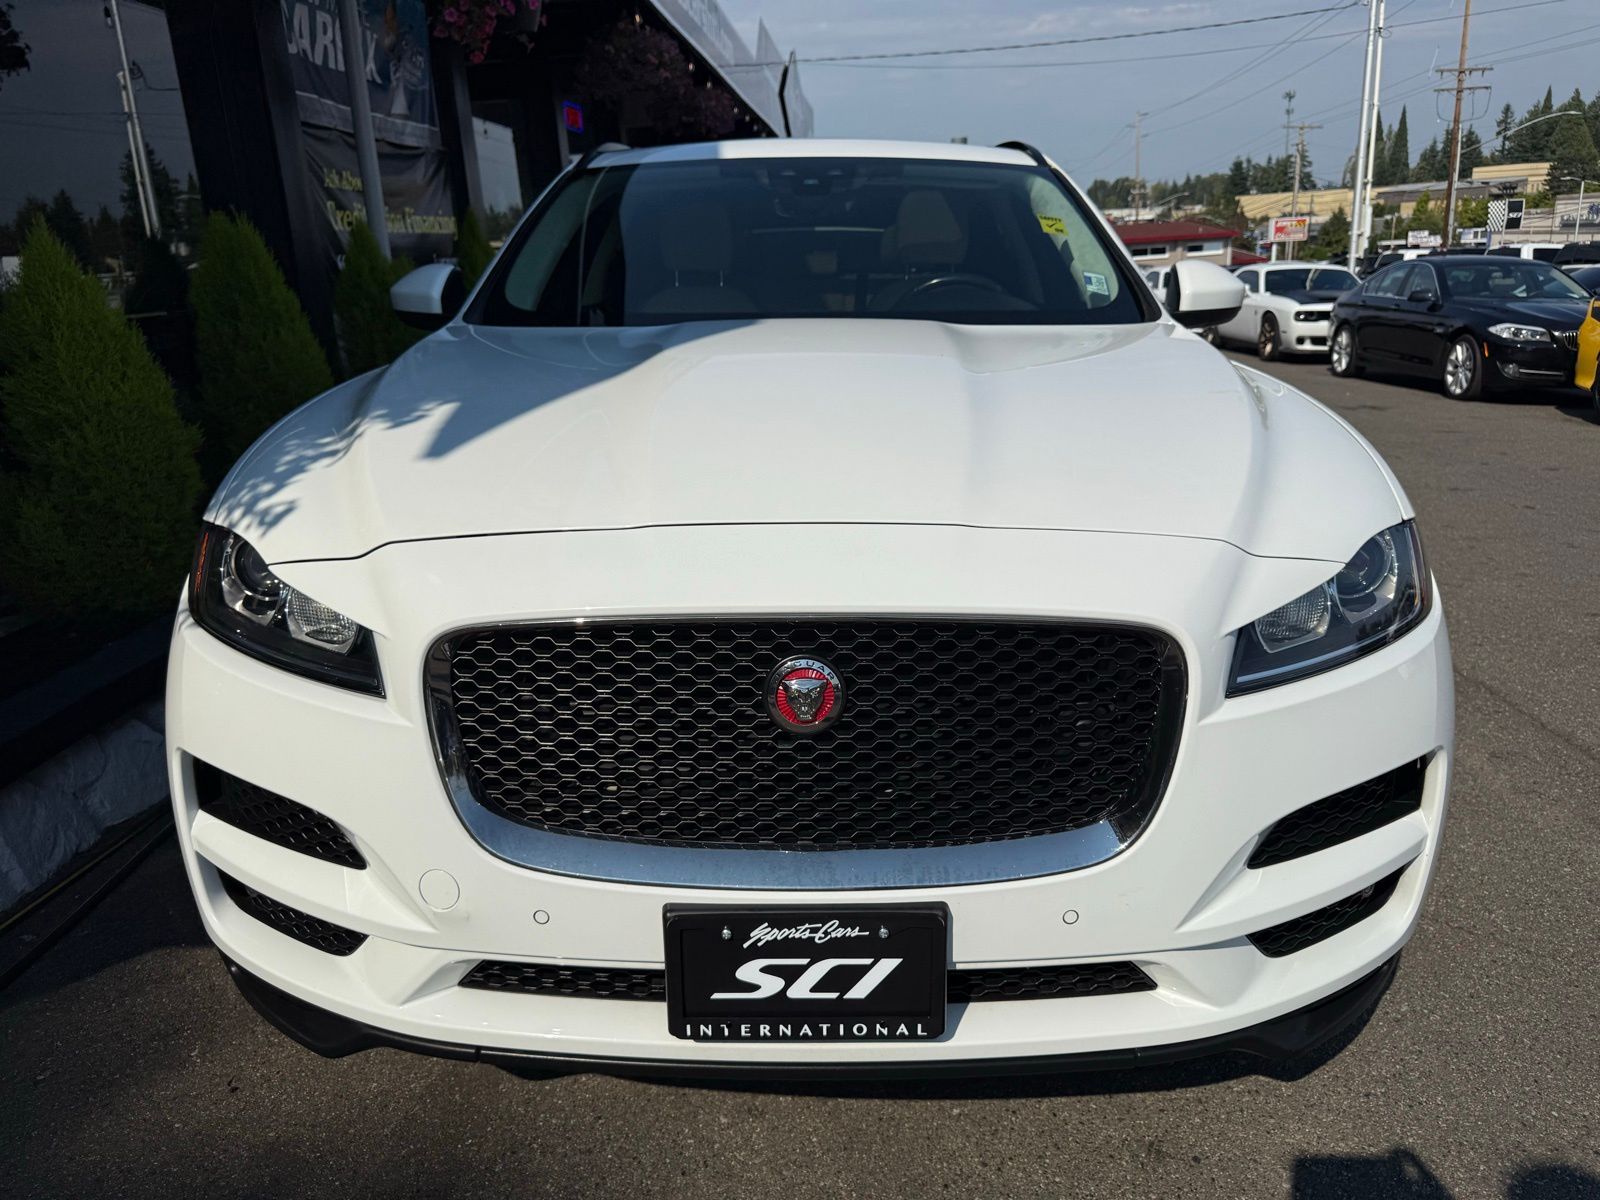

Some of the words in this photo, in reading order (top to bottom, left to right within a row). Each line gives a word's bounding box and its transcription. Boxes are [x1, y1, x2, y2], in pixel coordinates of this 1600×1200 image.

[280, 0, 384, 84] CARX
[743, 922, 822, 949] Sports
[815, 919, 870, 944] Cars
[709, 958, 904, 999] SCI
[685, 1022, 928, 1038] INTERNATIONAL
